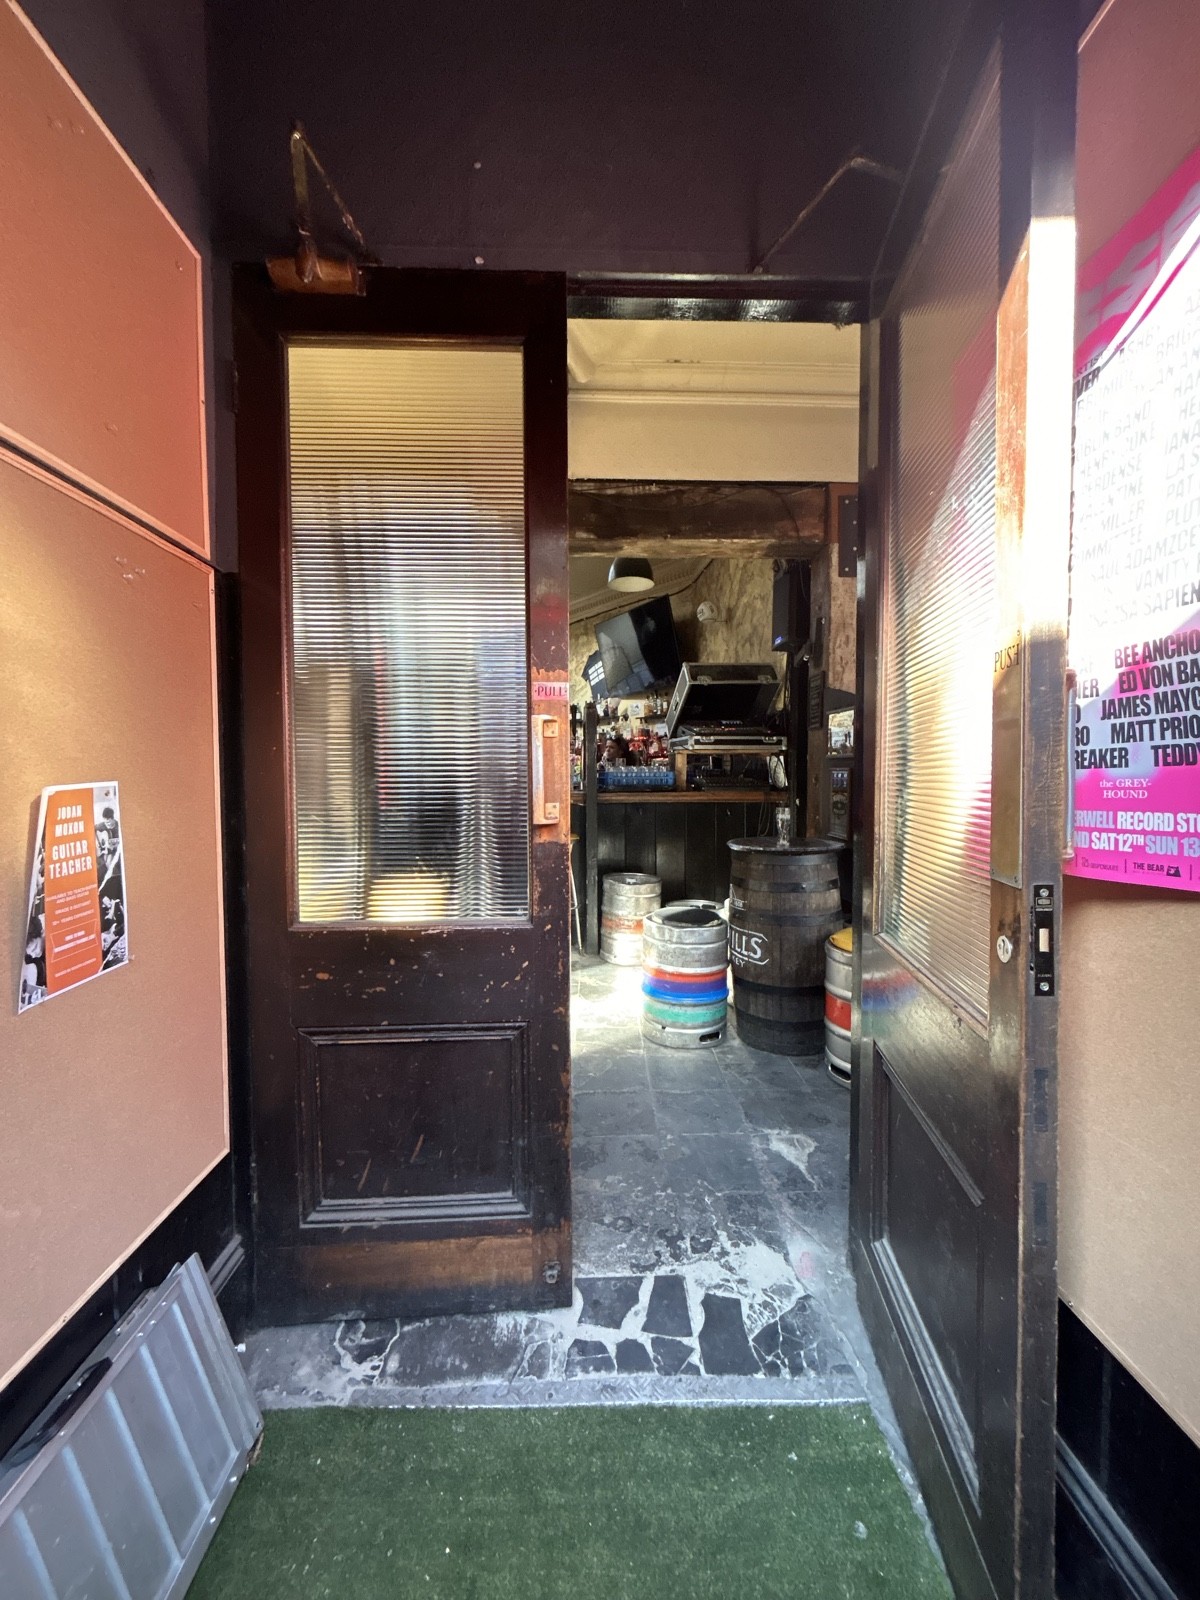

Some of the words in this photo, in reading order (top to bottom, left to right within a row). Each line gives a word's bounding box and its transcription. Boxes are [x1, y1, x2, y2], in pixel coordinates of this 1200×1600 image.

[994, 643, 1020, 672] PUSH
[1114, 644, 1140, 669] BEE
[1118, 670, 1138, 694] ED
[1138, 663, 1174, 690] VON
[537, 686, 566, 697] PULL
[1100, 694, 1152, 720] JAMES
[1110, 719, 1156, 744] MATT
[1100, 780, 1114, 788] the
[1116, 779, 1152, 788] GREY-
[1103, 790, 1148, 799] HOUND
[1116, 811, 1174, 832] RECORD
[52, 839, 88, 861] GUITAR
[1145, 834, 1178, 856] SUN
[49, 855, 93, 880] TEACHER
[1133, 862, 1146, 871] THE
[1147, 863, 1165, 872] BEAR
